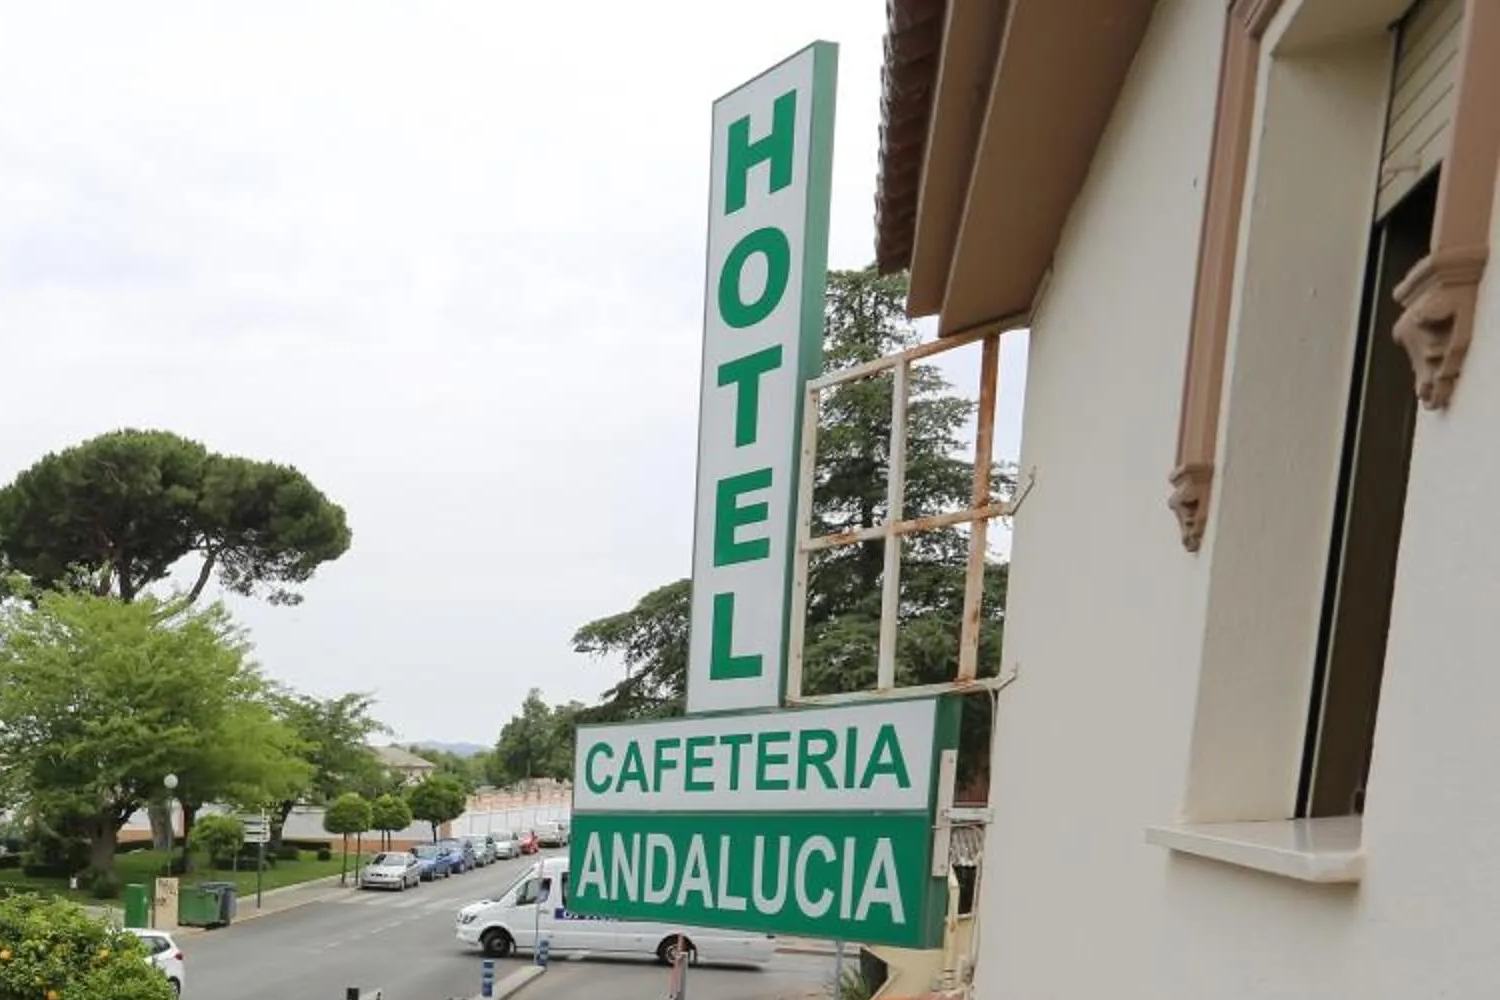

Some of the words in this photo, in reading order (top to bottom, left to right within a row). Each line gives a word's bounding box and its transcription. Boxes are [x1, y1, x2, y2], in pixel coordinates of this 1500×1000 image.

[708, 91, 796, 680] HOTEL
[584, 724, 910, 793] CAFETERIA
[577, 831, 905, 923] ANDALUCIA
